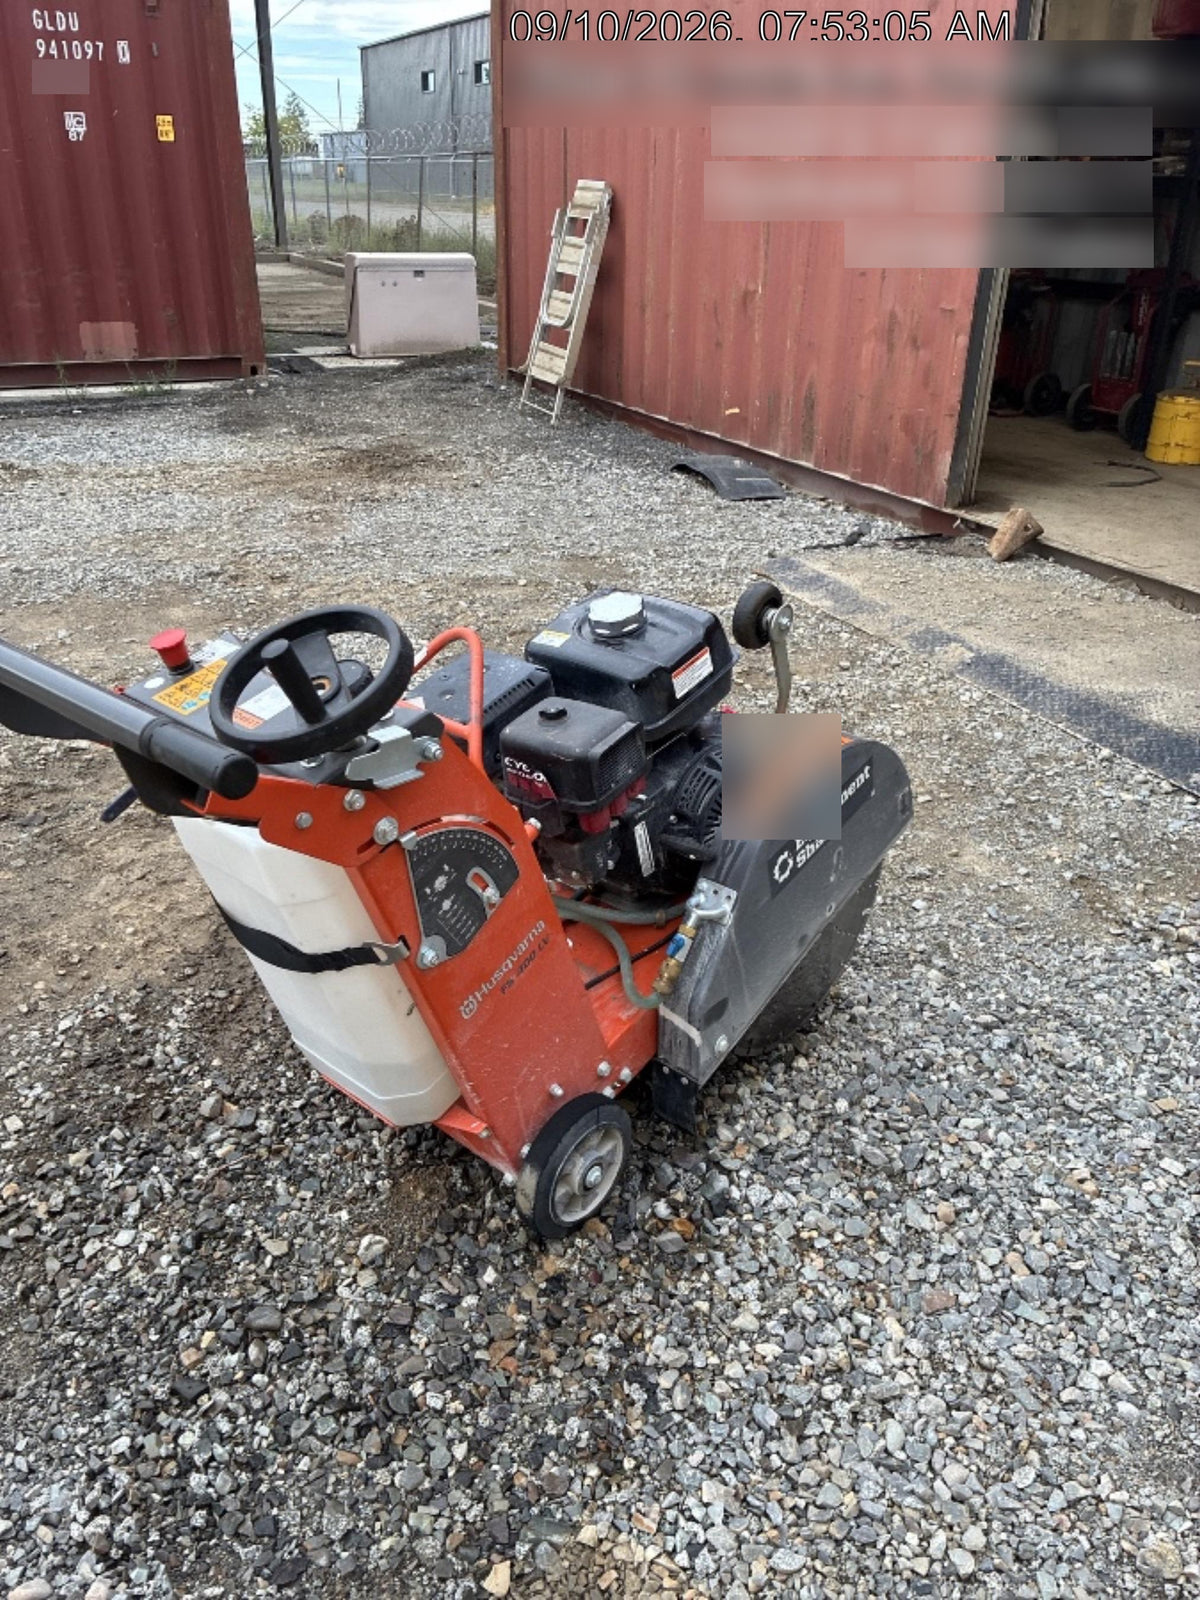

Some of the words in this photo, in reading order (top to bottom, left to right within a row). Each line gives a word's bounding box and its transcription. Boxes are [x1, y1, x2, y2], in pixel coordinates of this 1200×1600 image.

[32, 9, 79, 31] GLDU
[35, 38, 104, 61] 941097
[474, 920, 545, 1002] Husqvarna
